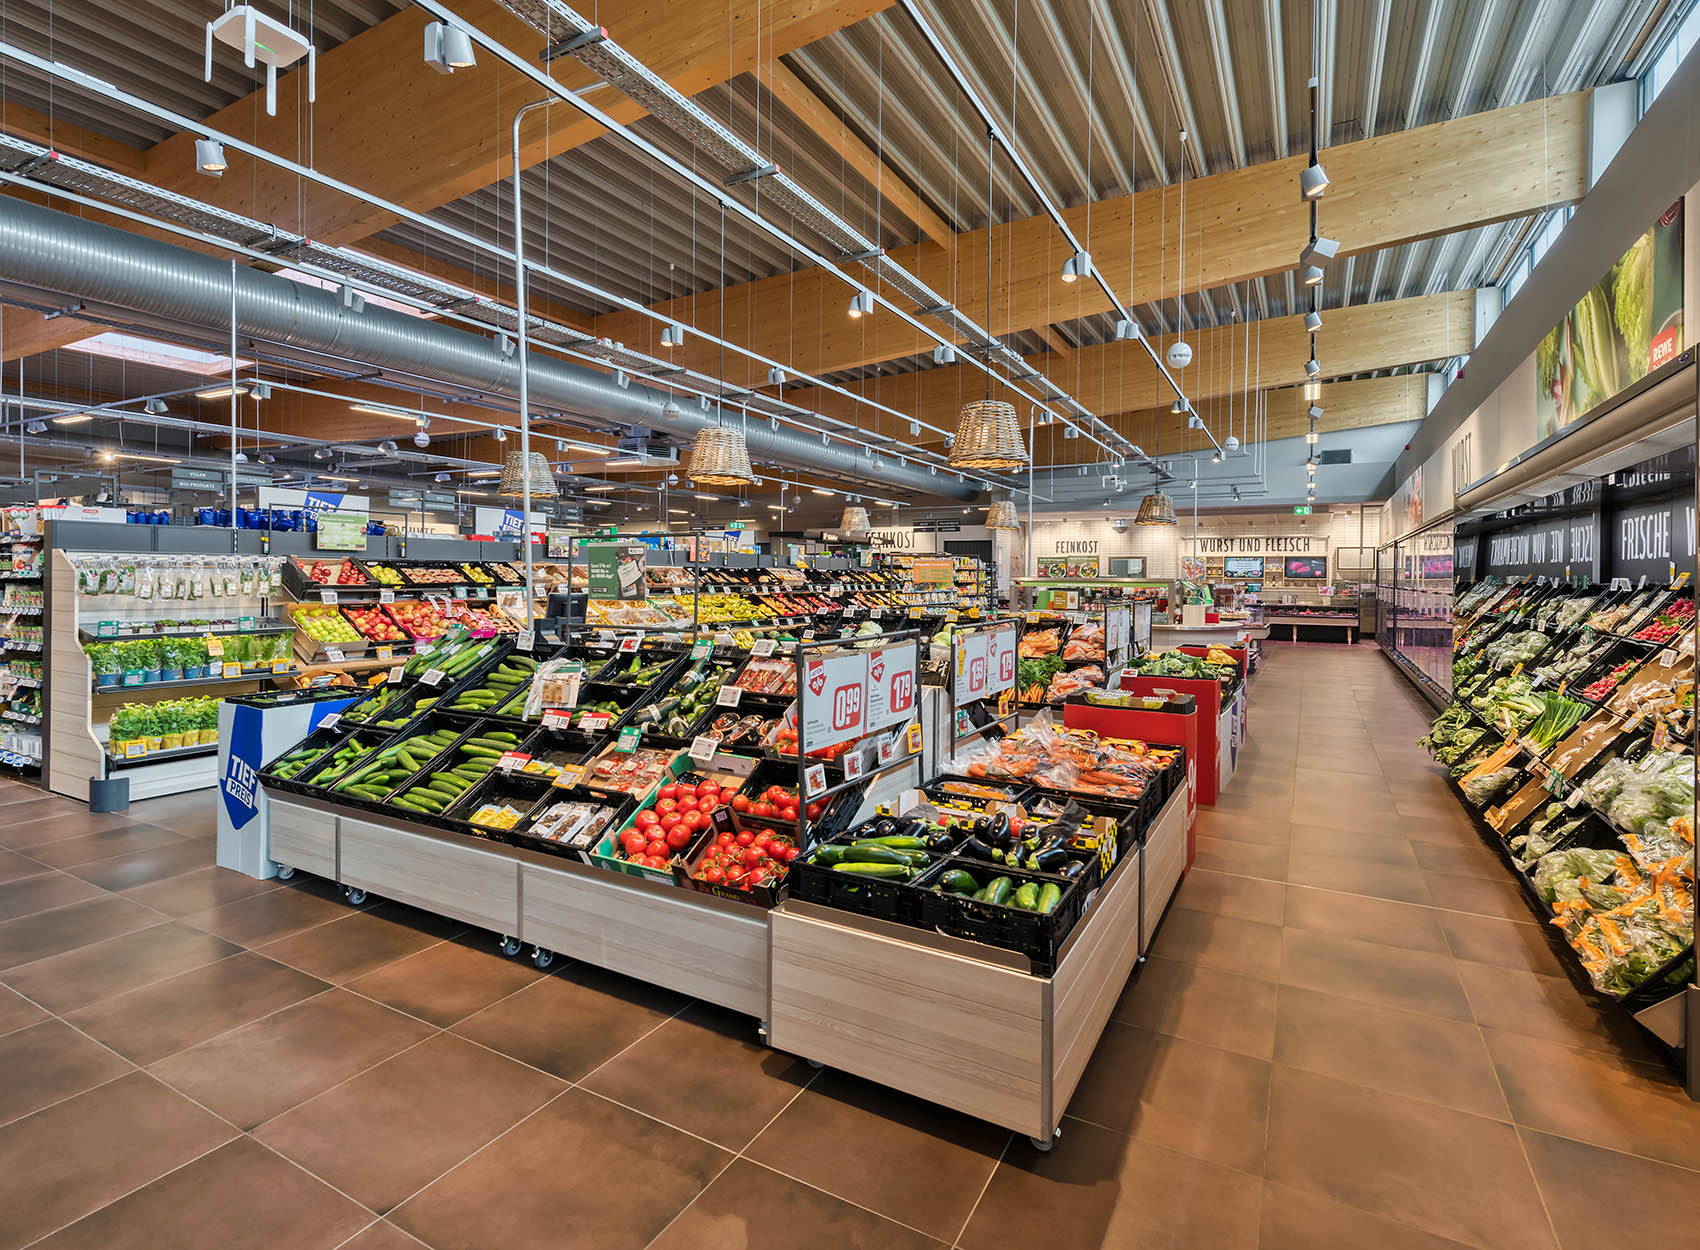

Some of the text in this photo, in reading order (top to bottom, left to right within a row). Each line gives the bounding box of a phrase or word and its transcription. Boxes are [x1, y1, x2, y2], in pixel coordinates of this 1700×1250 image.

[1653, 337, 1673, 362] REWE
[505, 513, 524, 529] TIEF
[1055, 540, 1098, 554] FEINKOST
[1200, 537, 1310, 553] WURST UND FLEISCH
[1621, 511, 1671, 561] FRISCHE
[232, 754, 257, 790] TIEF
[230, 781, 251, 806] PREIS
